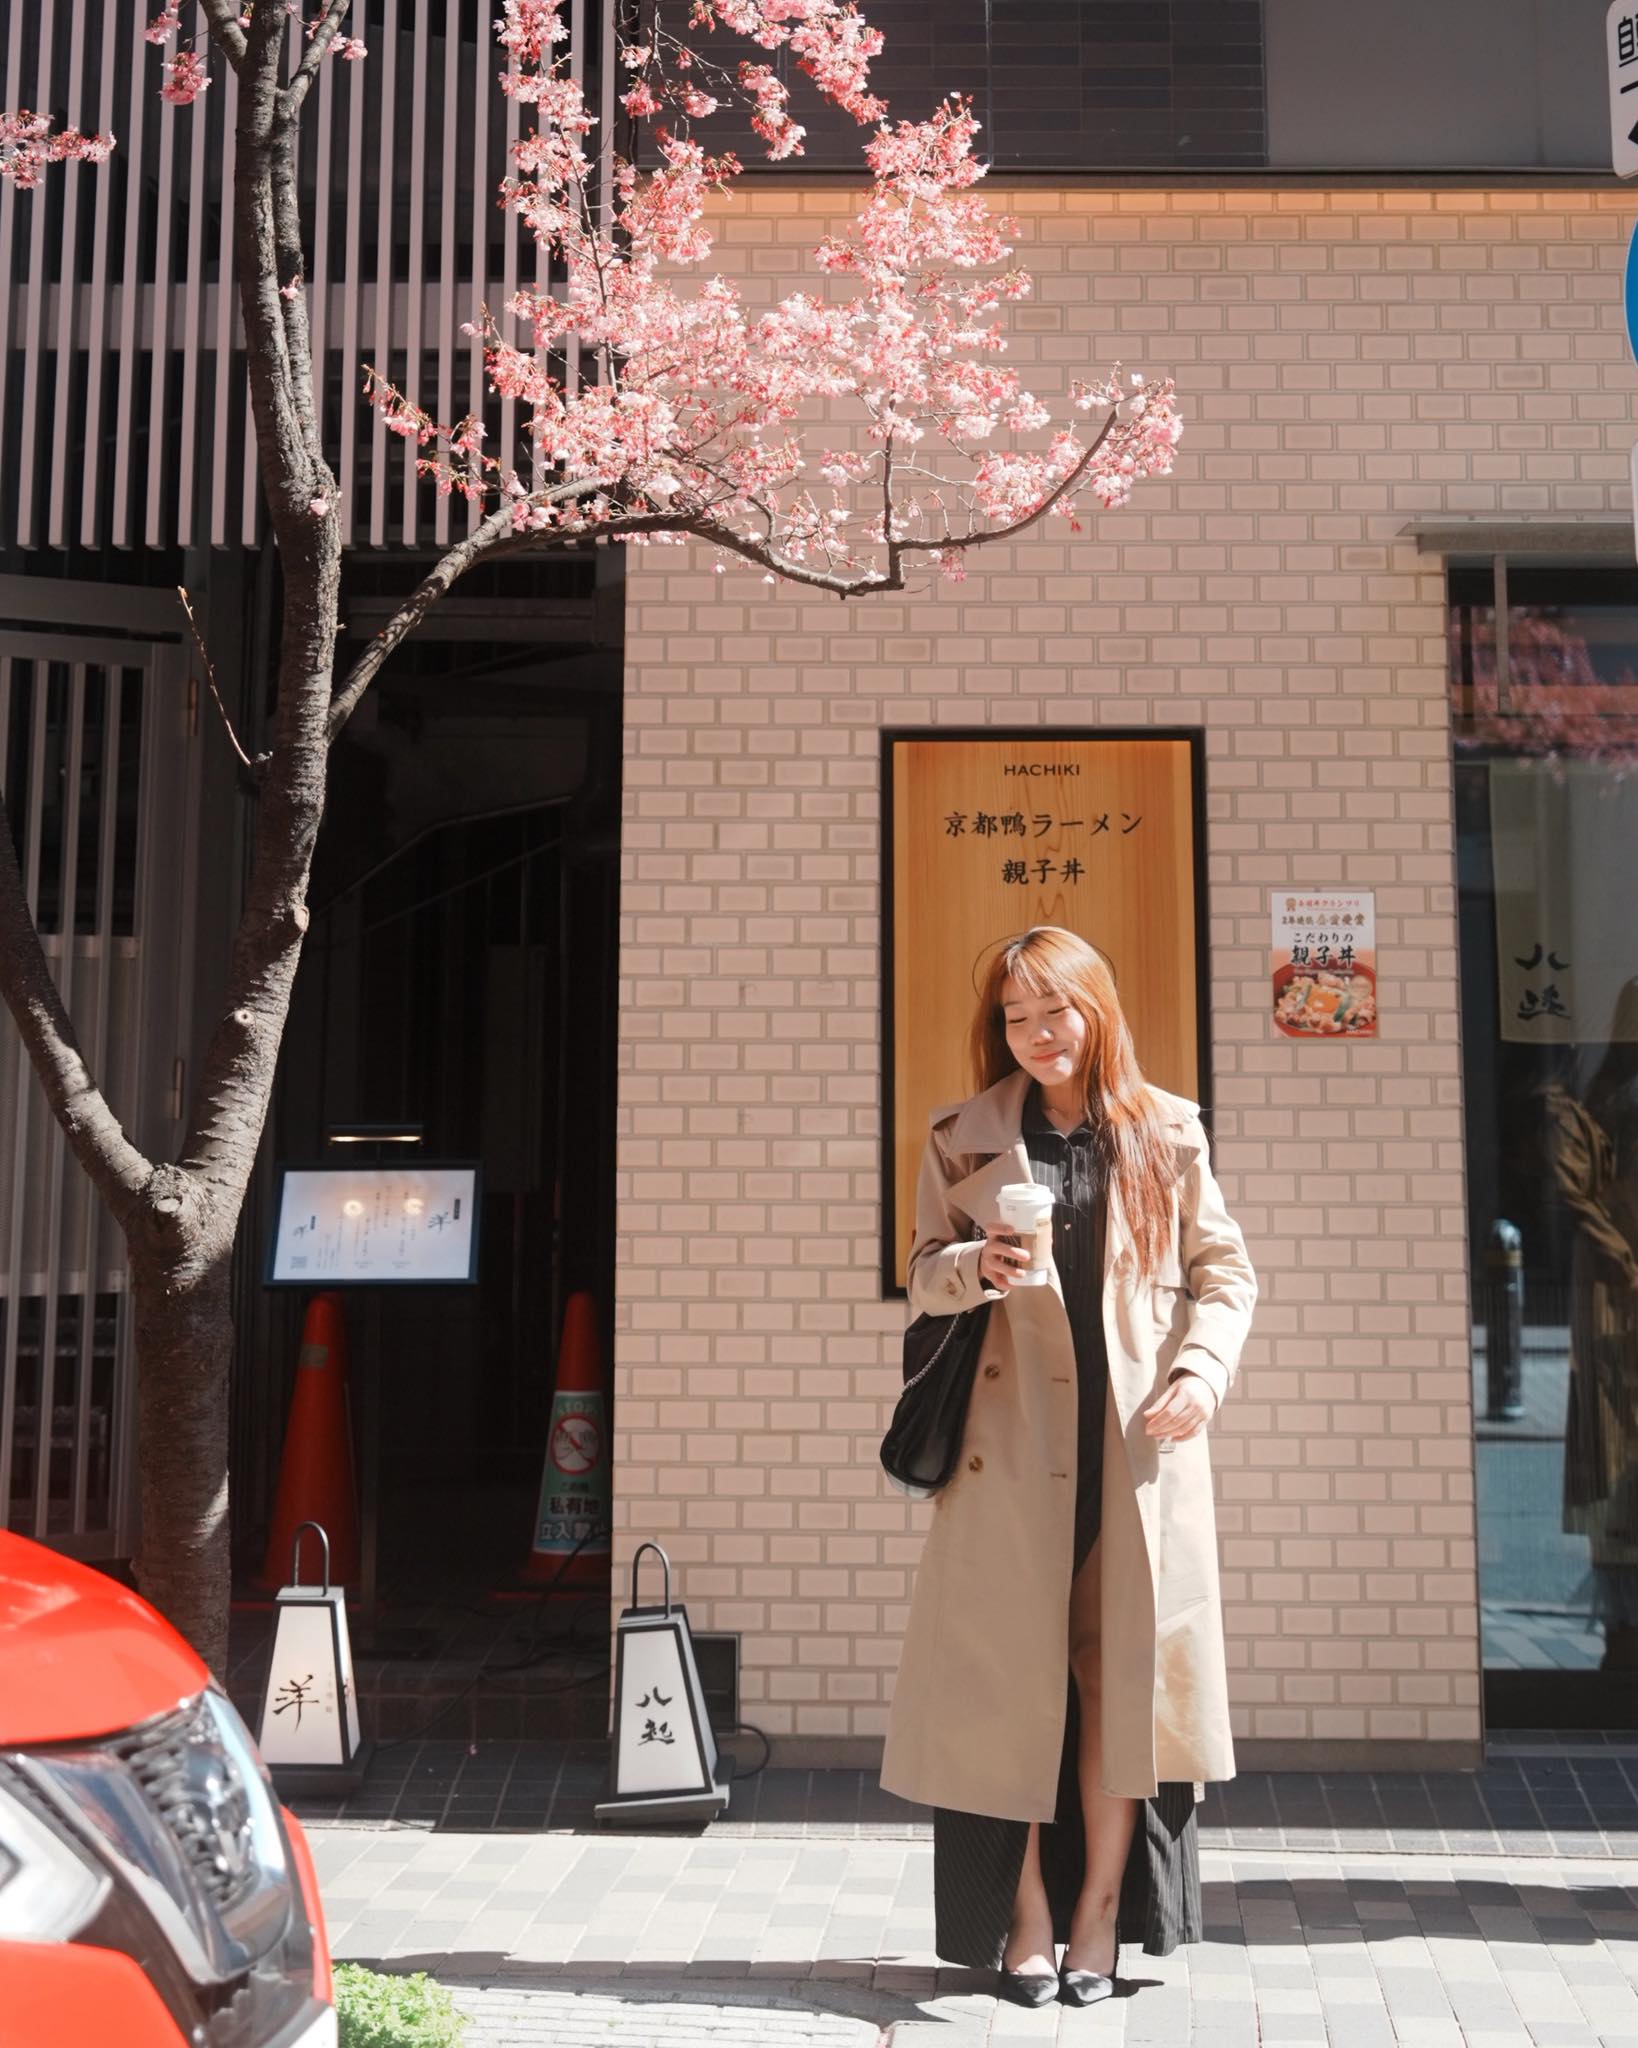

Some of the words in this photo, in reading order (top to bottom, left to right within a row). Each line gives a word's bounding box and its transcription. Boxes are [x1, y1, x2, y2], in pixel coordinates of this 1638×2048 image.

[1004, 764, 1081, 776] HACHIKI
[944, 811, 1142, 838] 京都鴨ラーメン
[1001, 858, 1086, 885] 親子丼
[1293, 932, 1354, 943] こだわりの
[1290, 945, 1356, 967] 親子丼
